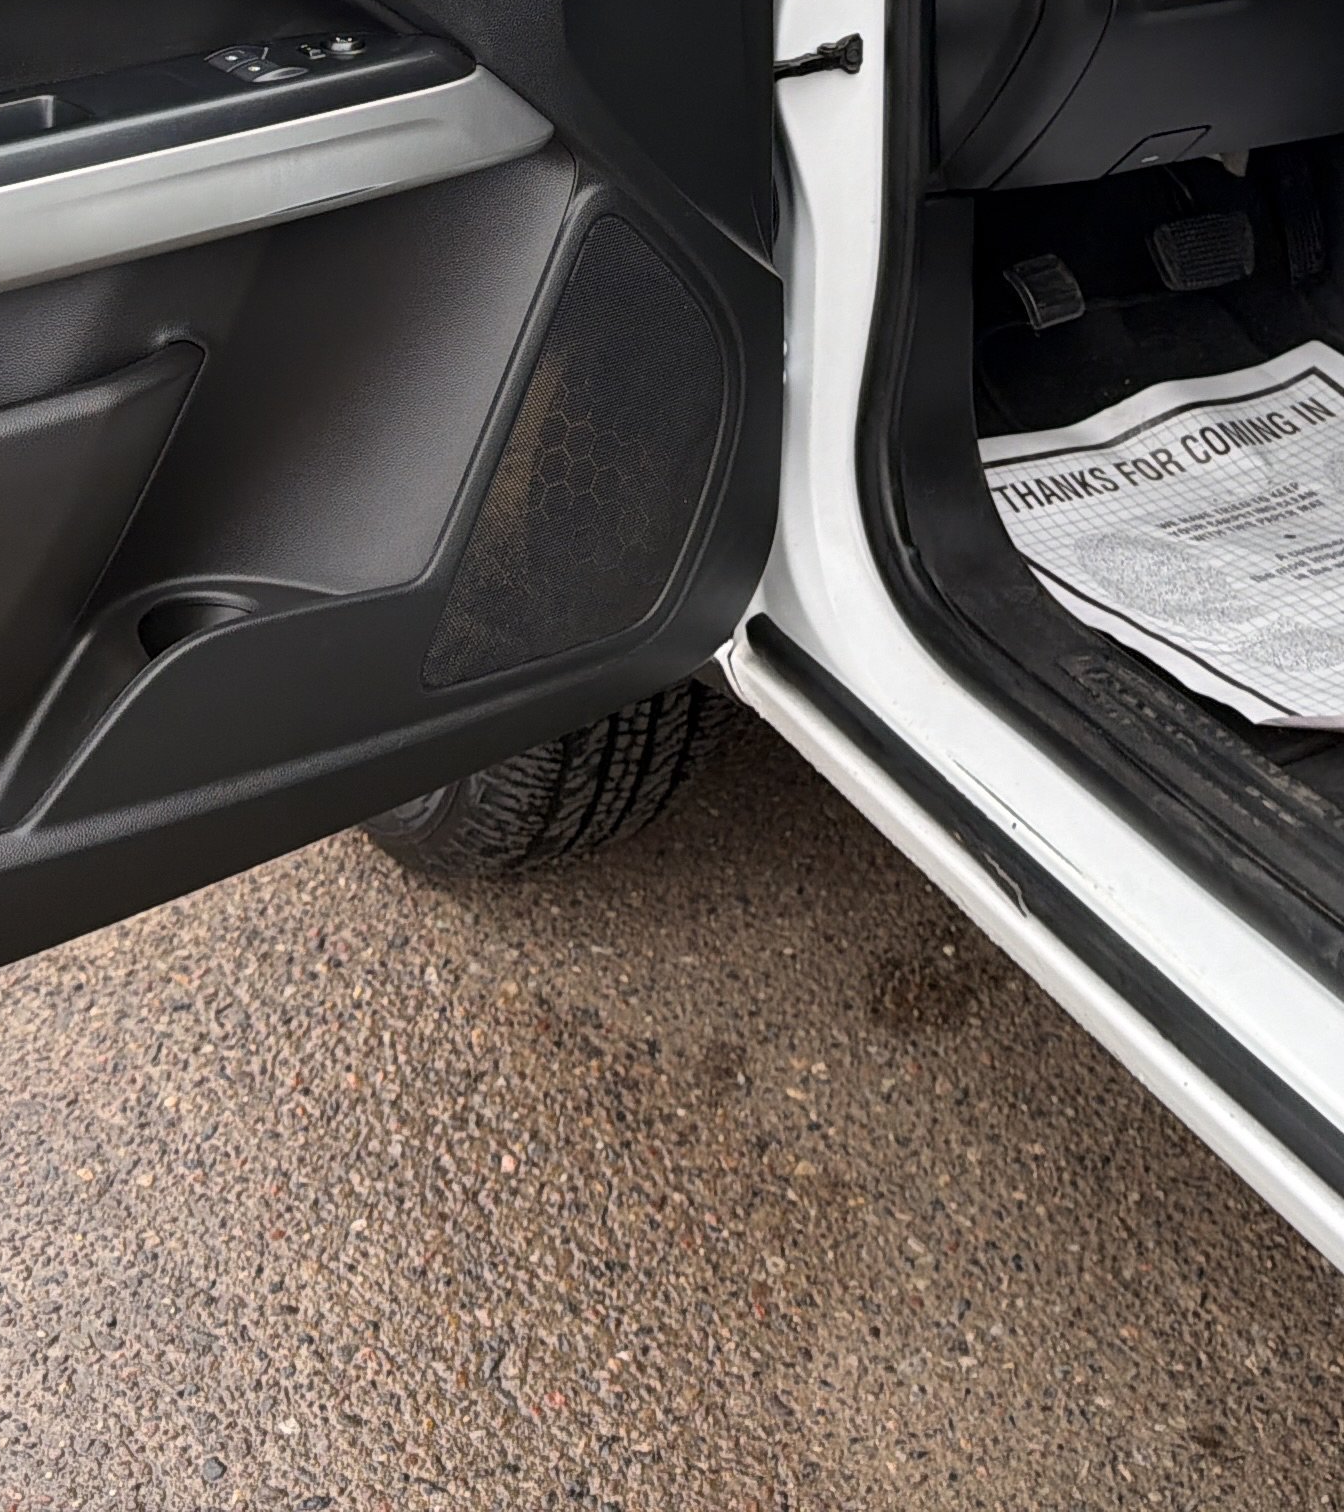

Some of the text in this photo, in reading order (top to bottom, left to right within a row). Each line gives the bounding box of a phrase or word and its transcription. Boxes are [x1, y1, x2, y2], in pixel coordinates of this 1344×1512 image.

[991, 395, 1338, 514] THANKS FOR COMING IN
[1270, 481, 1300, 499] KEEP
